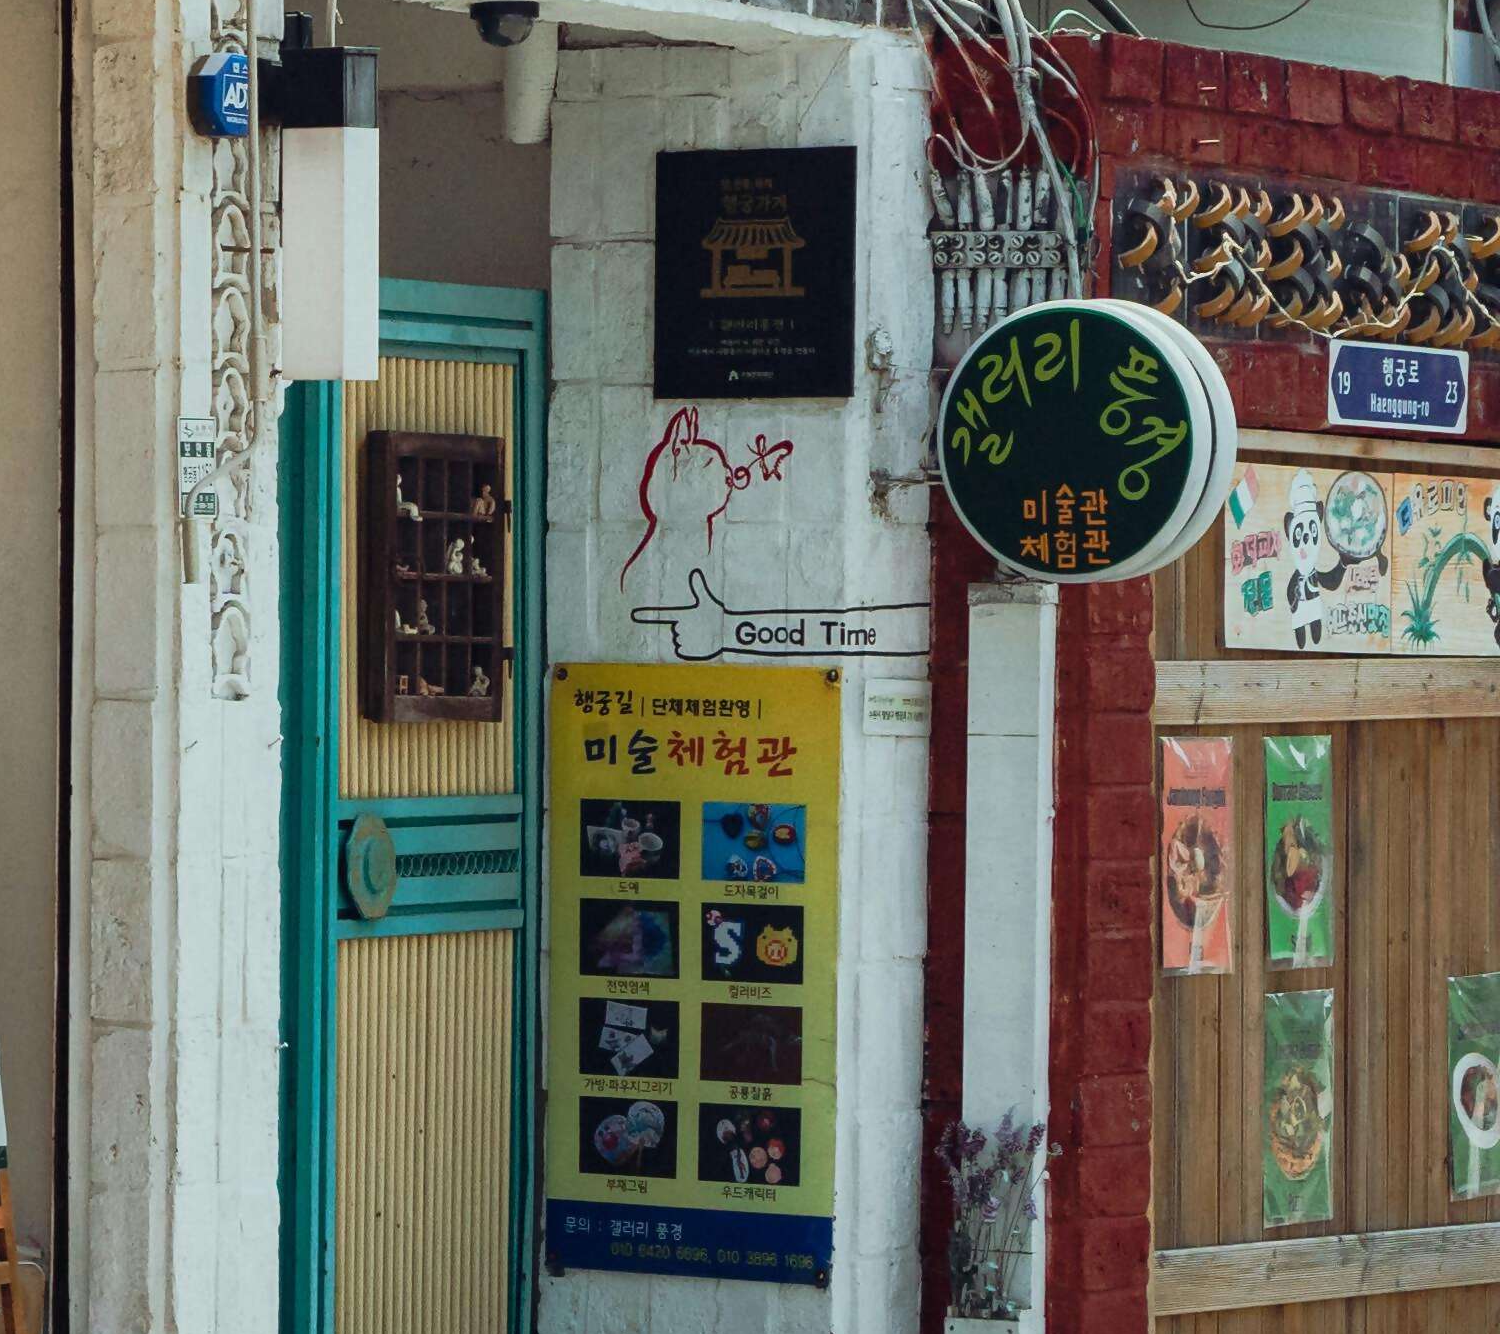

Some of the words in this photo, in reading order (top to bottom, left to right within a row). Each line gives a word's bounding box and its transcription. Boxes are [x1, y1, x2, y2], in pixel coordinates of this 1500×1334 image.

[1337, 370, 1352, 396] 19
[1381, 356, 1421, 388] 행궁로
[951, 318, 1081, 467] 갤러리
[1369, 391, 1431, 419] Haenggung-ro
[1444, 379, 1460, 405] 23
[1022, 482, 1110, 526] 미술관
[1019, 529, 1111, 569] 체험관
[735, 619, 806, 647] Good
[819, 620, 877, 647] Time
[573, 688, 634, 716] 행궁길
[651, 697, 751, 717] 단체체험환영
[563, 1216, 591, 1235] 문의
